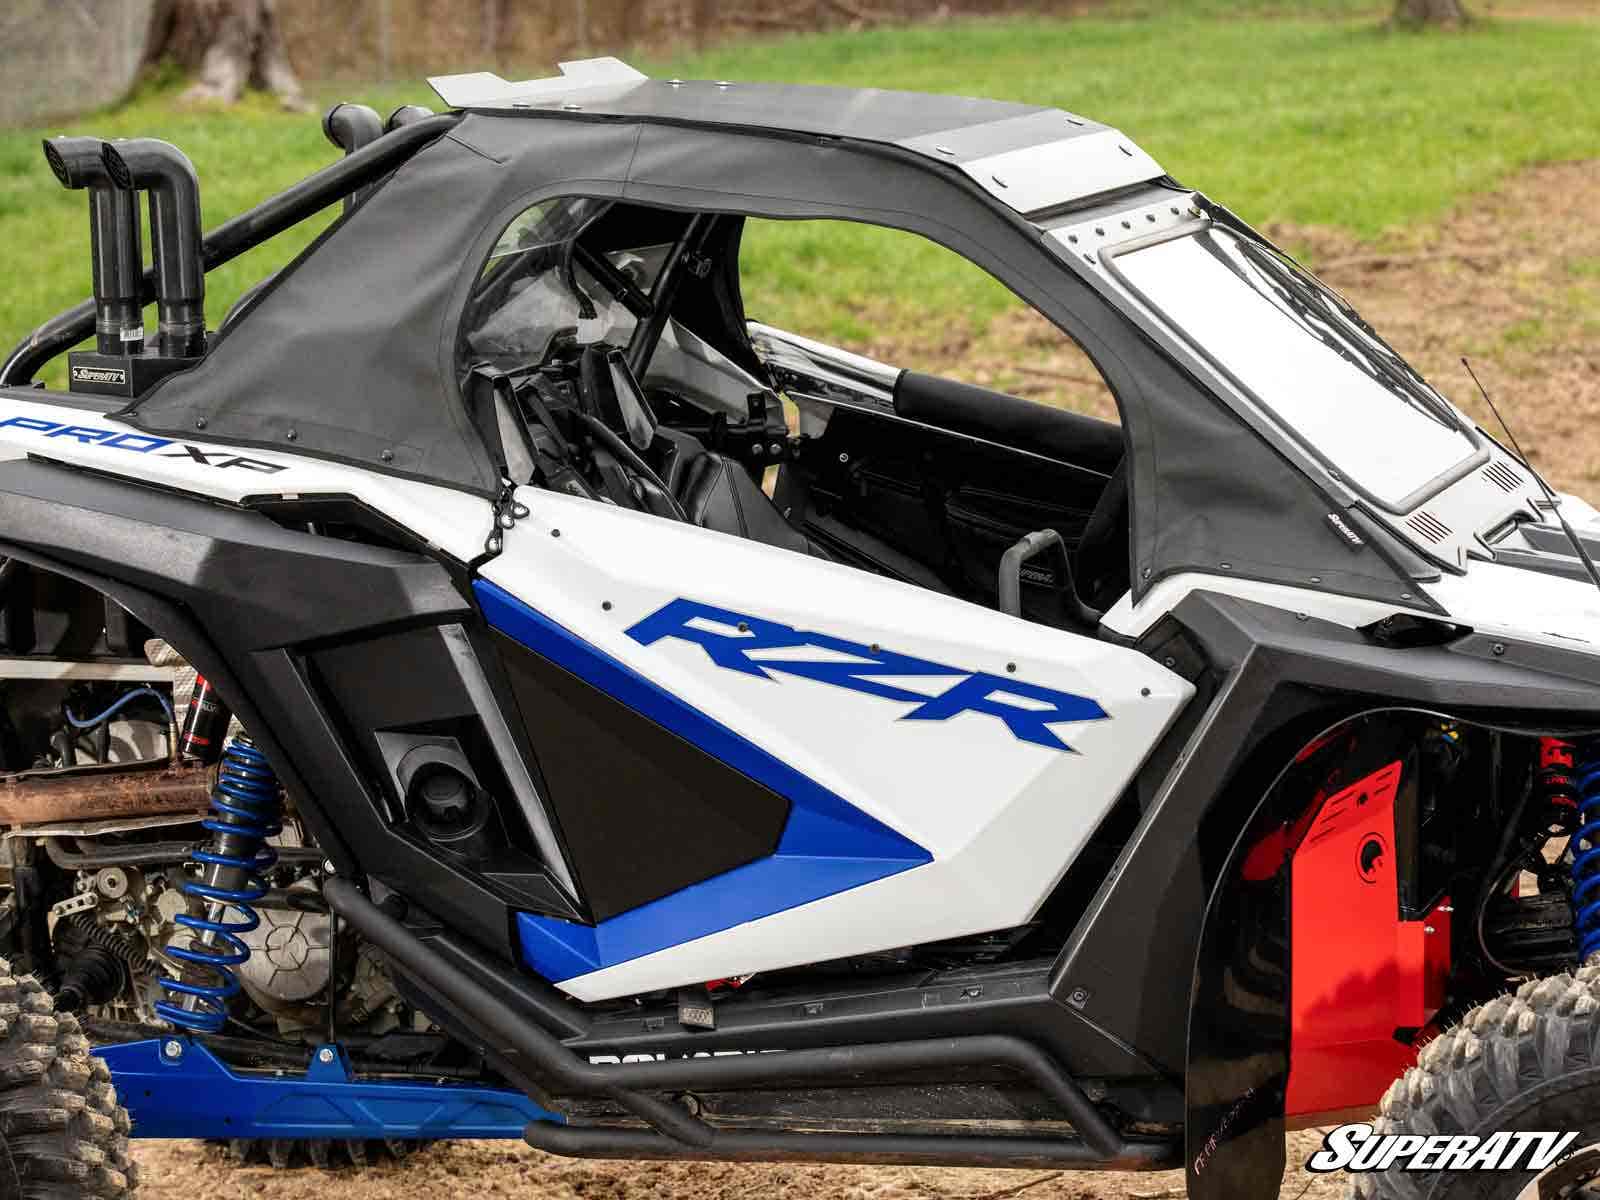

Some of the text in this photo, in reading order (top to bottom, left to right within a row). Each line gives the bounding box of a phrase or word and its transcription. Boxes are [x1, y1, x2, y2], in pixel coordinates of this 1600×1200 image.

[0, 416, 290, 475] PRO XP
[623, 597, 1113, 755] RZR
